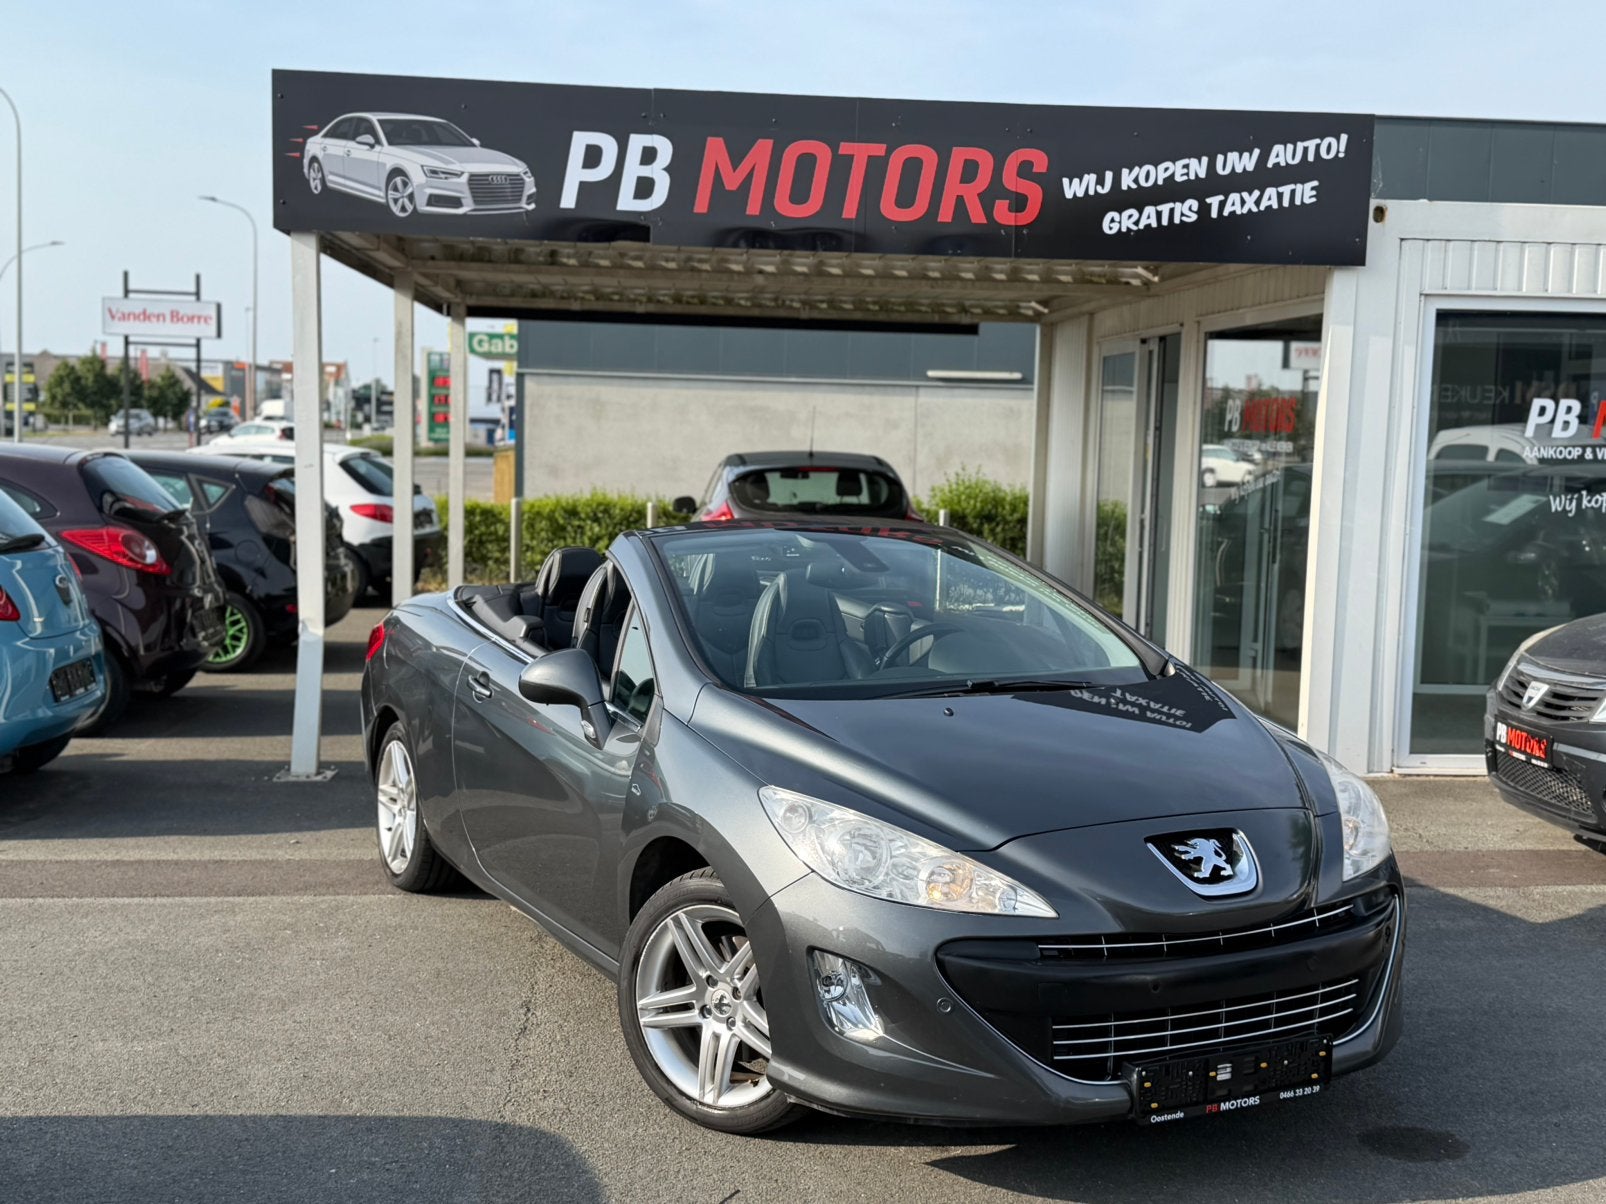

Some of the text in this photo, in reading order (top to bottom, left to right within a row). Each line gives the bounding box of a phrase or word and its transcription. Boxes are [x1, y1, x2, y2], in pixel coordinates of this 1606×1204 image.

[559, 130, 1049, 226] PB MOTORS
[1062, 133, 1348, 199] WIJ KOPEN UW AUTO!
[1102, 180, 1319, 235] GRATIS TAXATIE
[107, 307, 213, 325] Vanden Borre
[1224, 396, 1297, 433] PB MOTORS
[1524, 398, 1582, 438] PB
[1523, 446, 1582, 460] AANKOOP
[1584, 447, 1594, 460] &
[1549, 494, 1579, 517] Wij
[1496, 722, 1507, 743] PB
[1507, 727, 1547, 758] MOTORS
[1150, 1096, 1260, 1123] Oostende PB MOTORS
[1279, 1090, 1295, 1100] 0466
